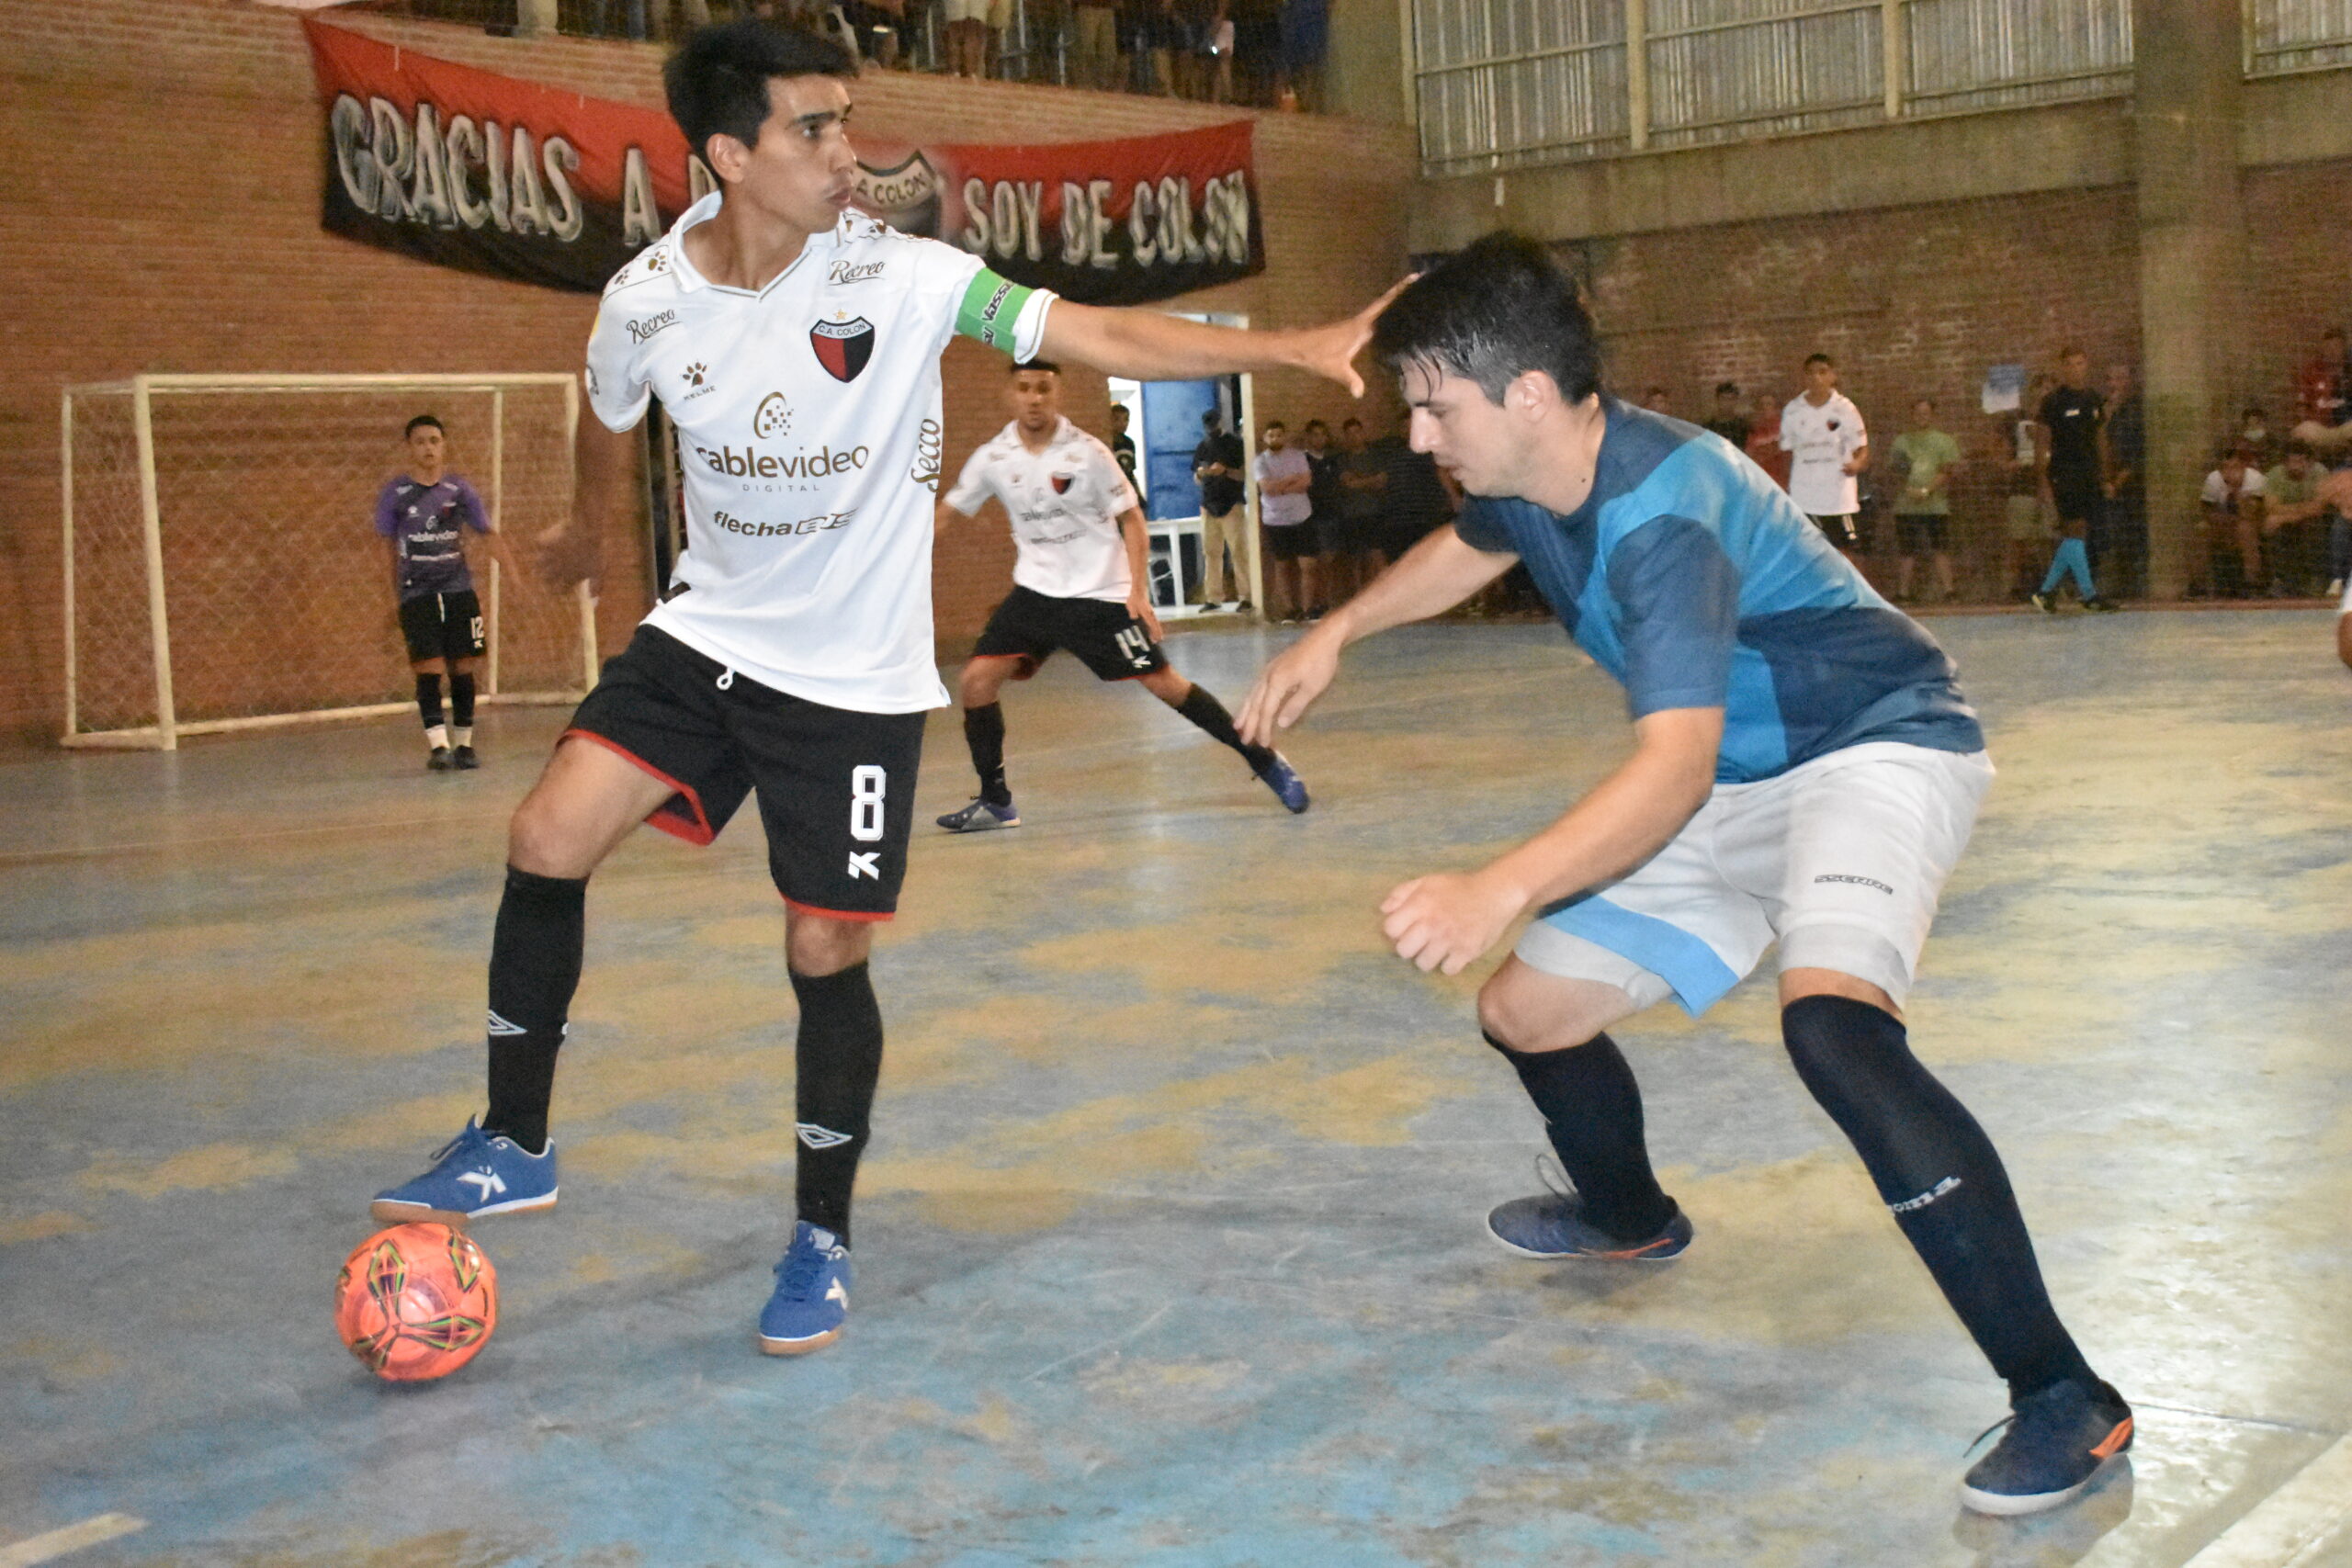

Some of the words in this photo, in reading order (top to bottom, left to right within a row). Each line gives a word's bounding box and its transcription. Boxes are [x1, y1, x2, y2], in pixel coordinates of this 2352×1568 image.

[332, 95, 584, 243] GRACIAS
[965, 178, 1043, 261] SOY
[1062, 180, 1119, 268] DE
[828, 260, 886, 287] Recreo
[626, 309, 683, 345] Recreo
[837, 322, 866, 336] COLON
[910, 418, 940, 492] Secco
[742, 483, 820, 492] DIGITAL
[470, 615, 484, 639] 12
[1114, 625, 1150, 660] 14
[851, 765, 887, 840] 8
